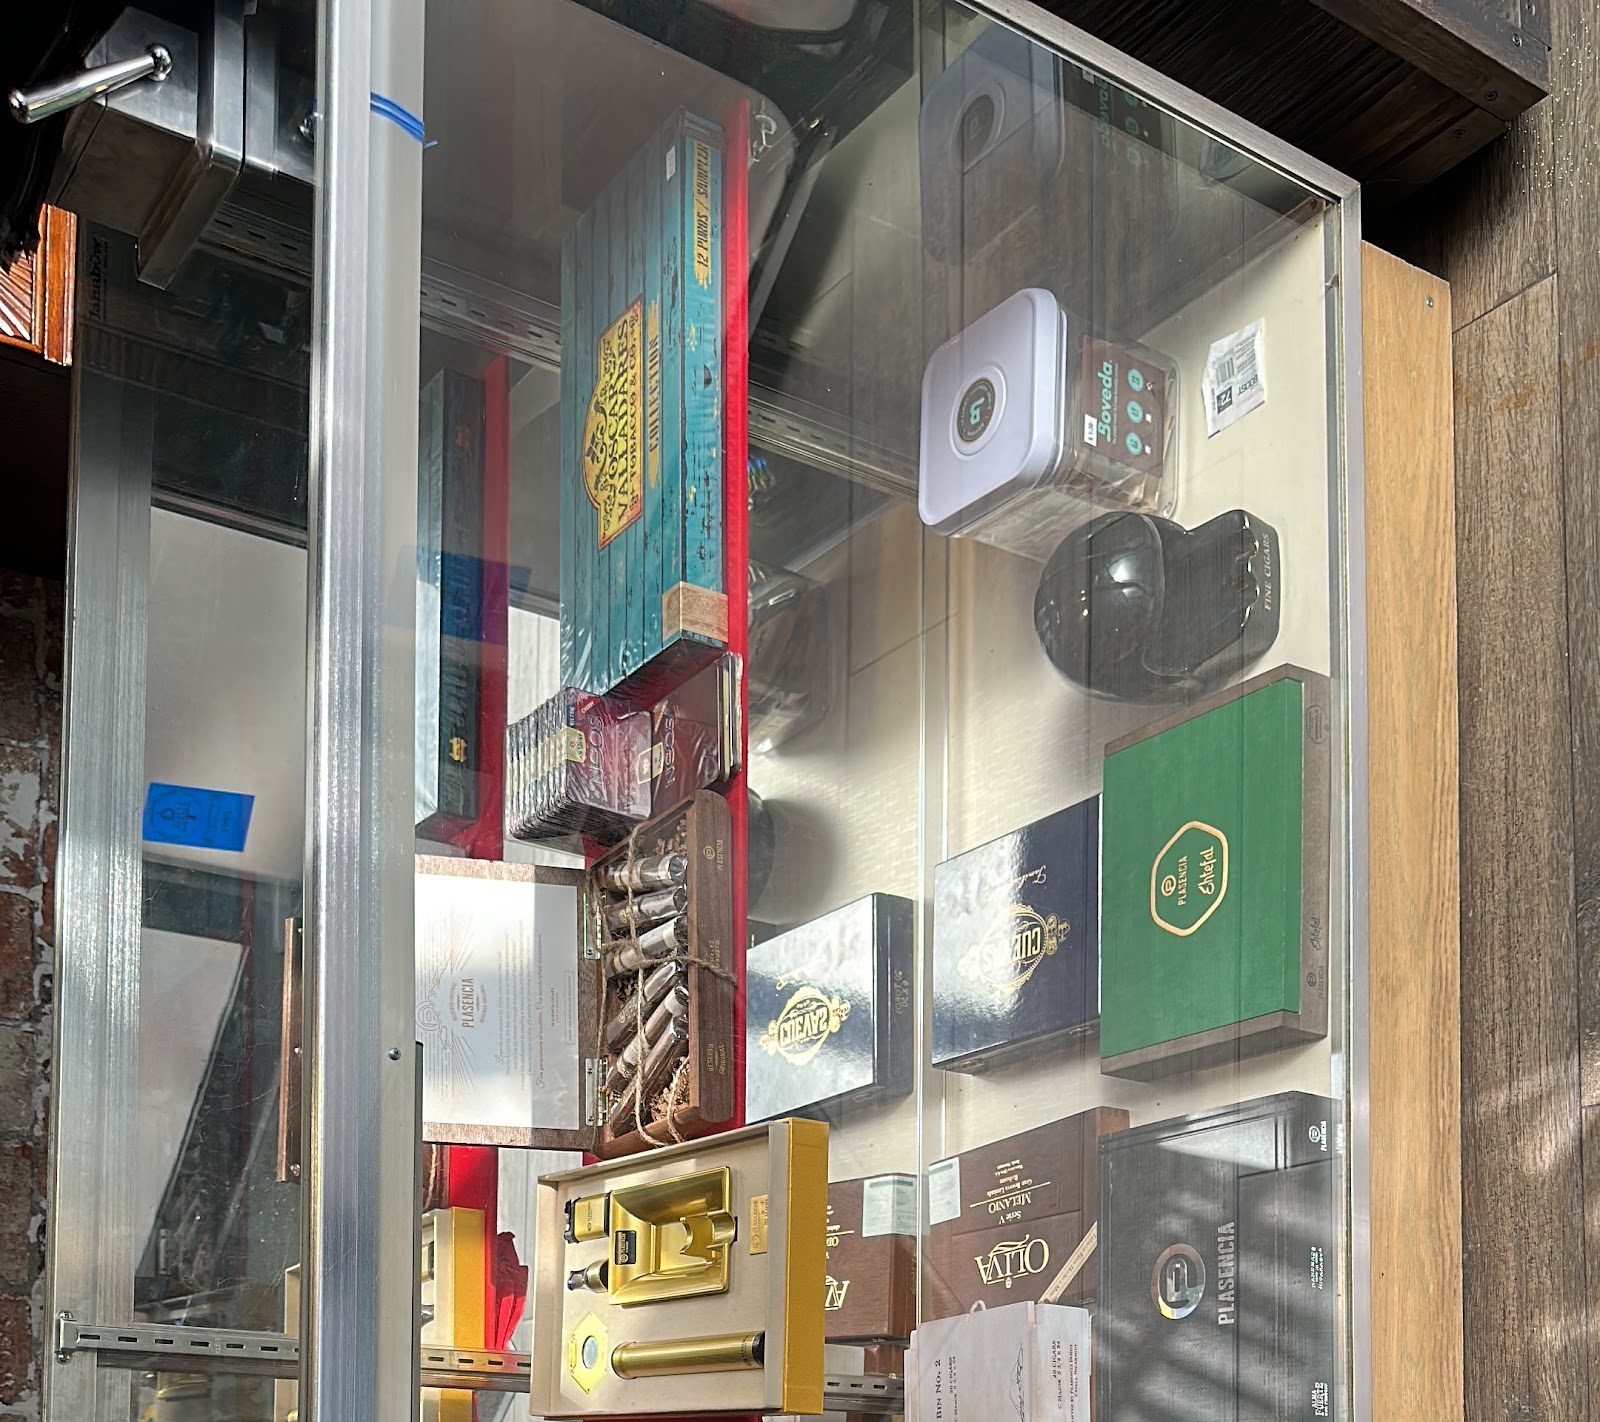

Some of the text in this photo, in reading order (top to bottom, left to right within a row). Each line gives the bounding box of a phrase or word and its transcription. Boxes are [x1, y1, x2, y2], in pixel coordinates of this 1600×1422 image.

[697, 142, 708, 198] SAMPLER
[697, 212, 708, 251] PUROS
[697, 252, 708, 268] 12
[630, 373, 637, 386] &
[648, 335, 659, 452] COLLECTION
[1098, 362, 1113, 442] Boveda
[608, 381, 619, 480] OSCAR
[618, 319, 628, 524] VALLADARES
[629, 393, 637, 478] TOBACCO
[1262, 534, 1272, 612] FINE CIGARS
[716, 838, 724, 871] PLASENCIA
[1198, 846, 1217, 894] Ehtefal
[1177, 856, 1188, 906] PLASENCIA
[462, 978, 474, 1028] PLASENCIA
[1320, 1120, 1328, 1152] PLASENCIA
[988, 1190, 1032, 1214] MELANIO
[1006, 1210, 1022, 1223] Serie
[974, 1238, 1050, 1284] OLIVA
[1218, 1222, 1236, 1324] PLASENCIA
[934, 1358, 941, 1368] 2
[1315, 1382, 1324, 1416] FUERTE
